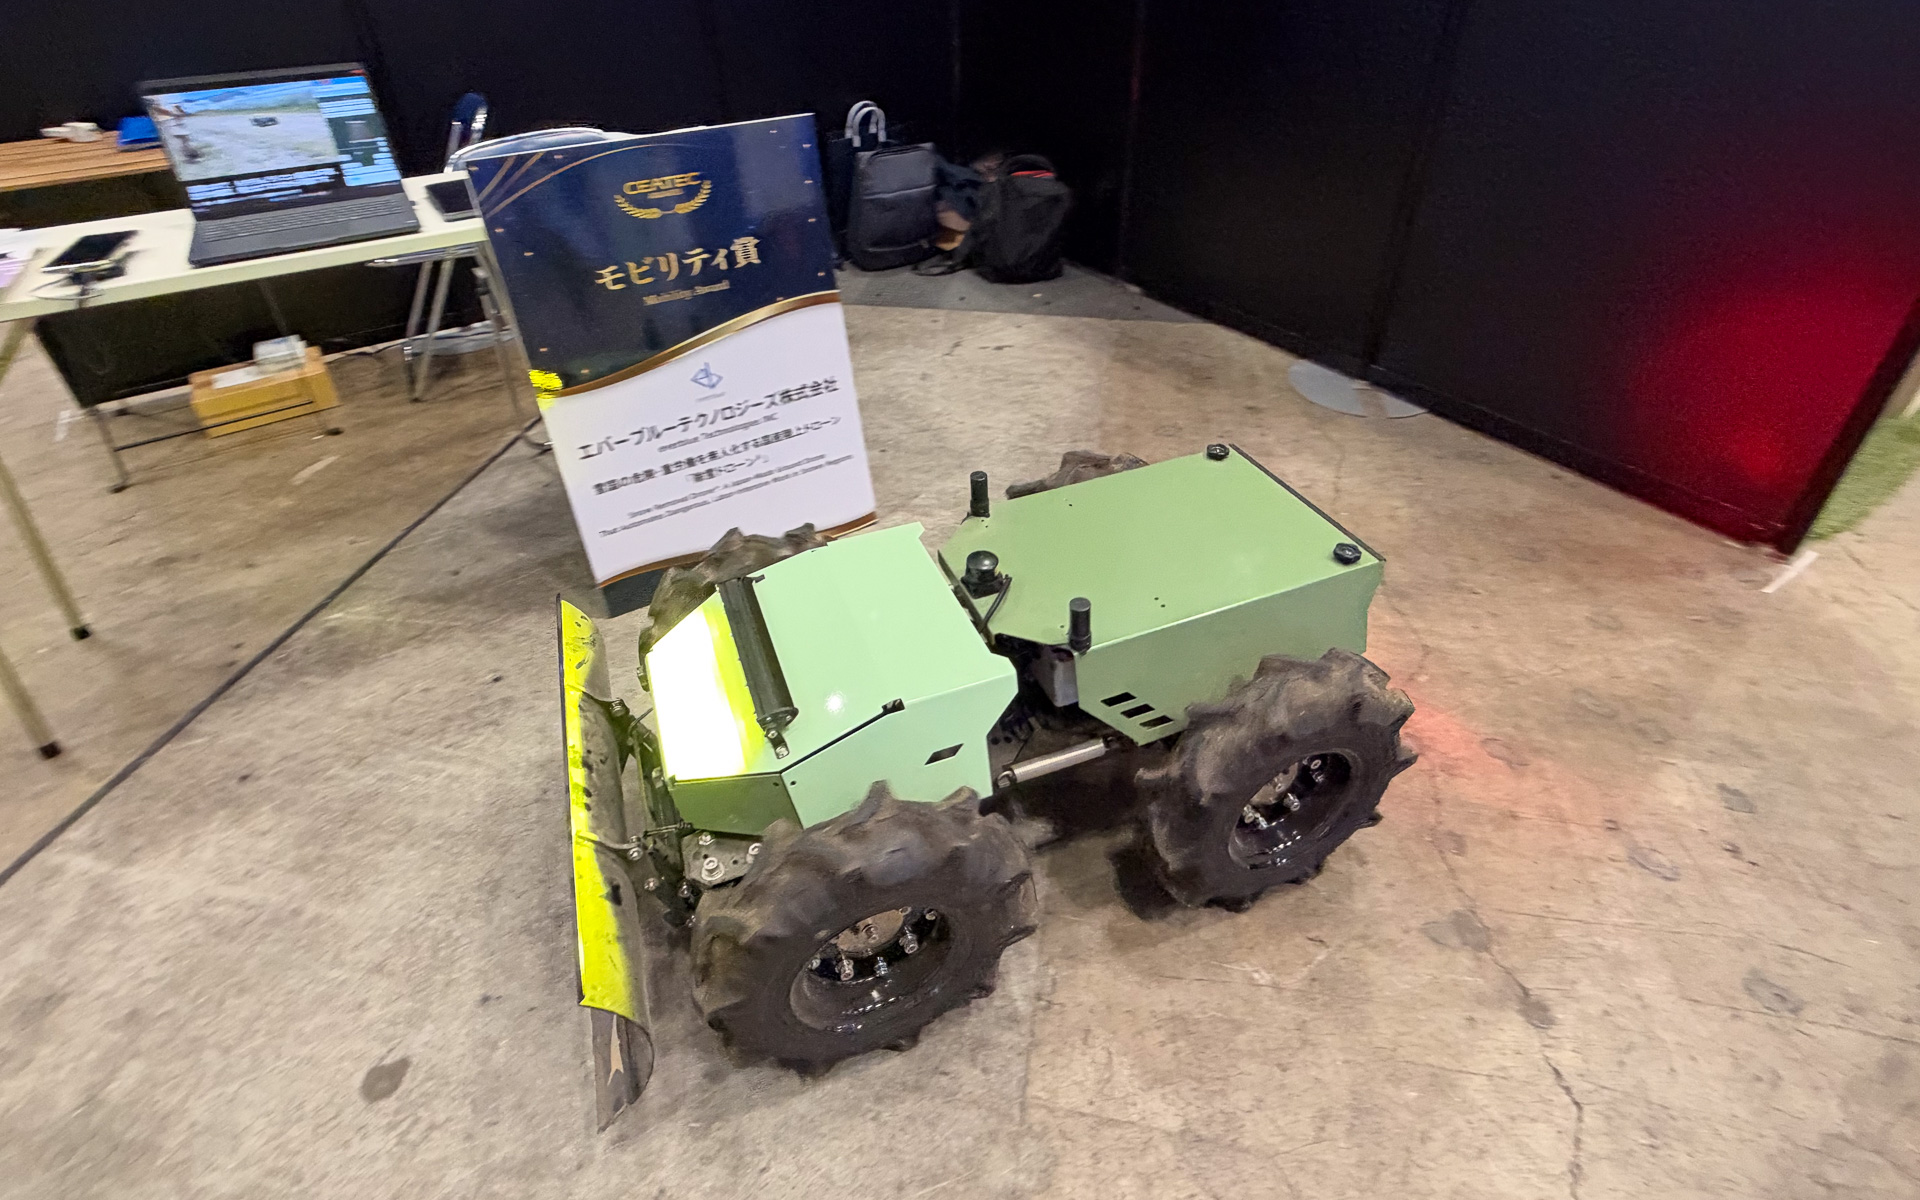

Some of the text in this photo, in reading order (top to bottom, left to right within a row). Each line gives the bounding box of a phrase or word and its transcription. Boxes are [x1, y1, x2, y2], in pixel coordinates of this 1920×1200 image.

[622, 172, 702, 194] CEATEC
[594, 236, 763, 291] モビリティ賞
[577, 378, 839, 460] エバーブルーテクノロジーズ株式会社
